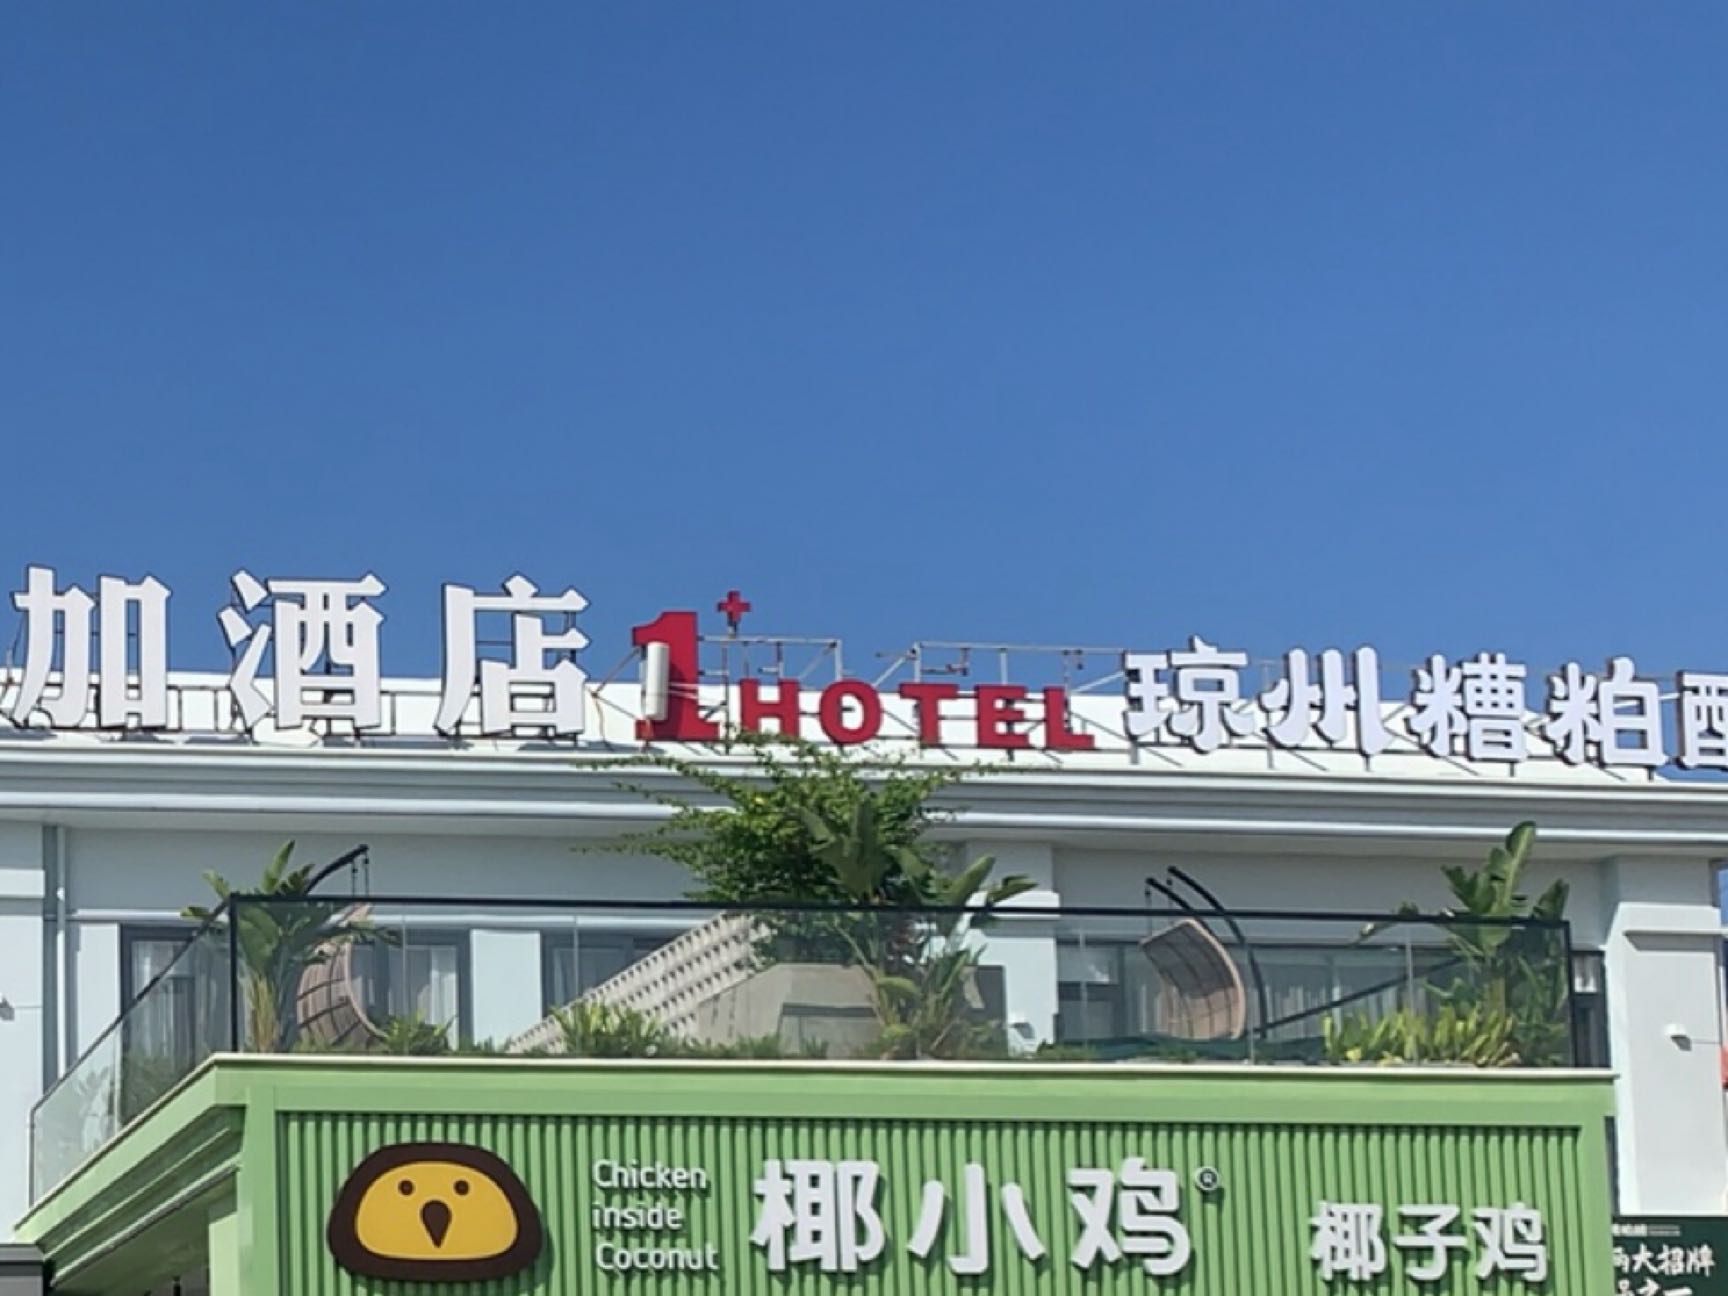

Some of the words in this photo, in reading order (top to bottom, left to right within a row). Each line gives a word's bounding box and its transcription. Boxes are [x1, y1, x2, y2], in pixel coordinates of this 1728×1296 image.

[739, 678, 1095, 750] HOTEL
[593, 1158, 708, 1190] Chicken
[592, 1201, 683, 1231] inside
[750, 1157, 1192, 1276] 椰小鸡
[1309, 1201, 1549, 1283] 椰子鸡
[595, 1242, 720, 1271] Coconut
